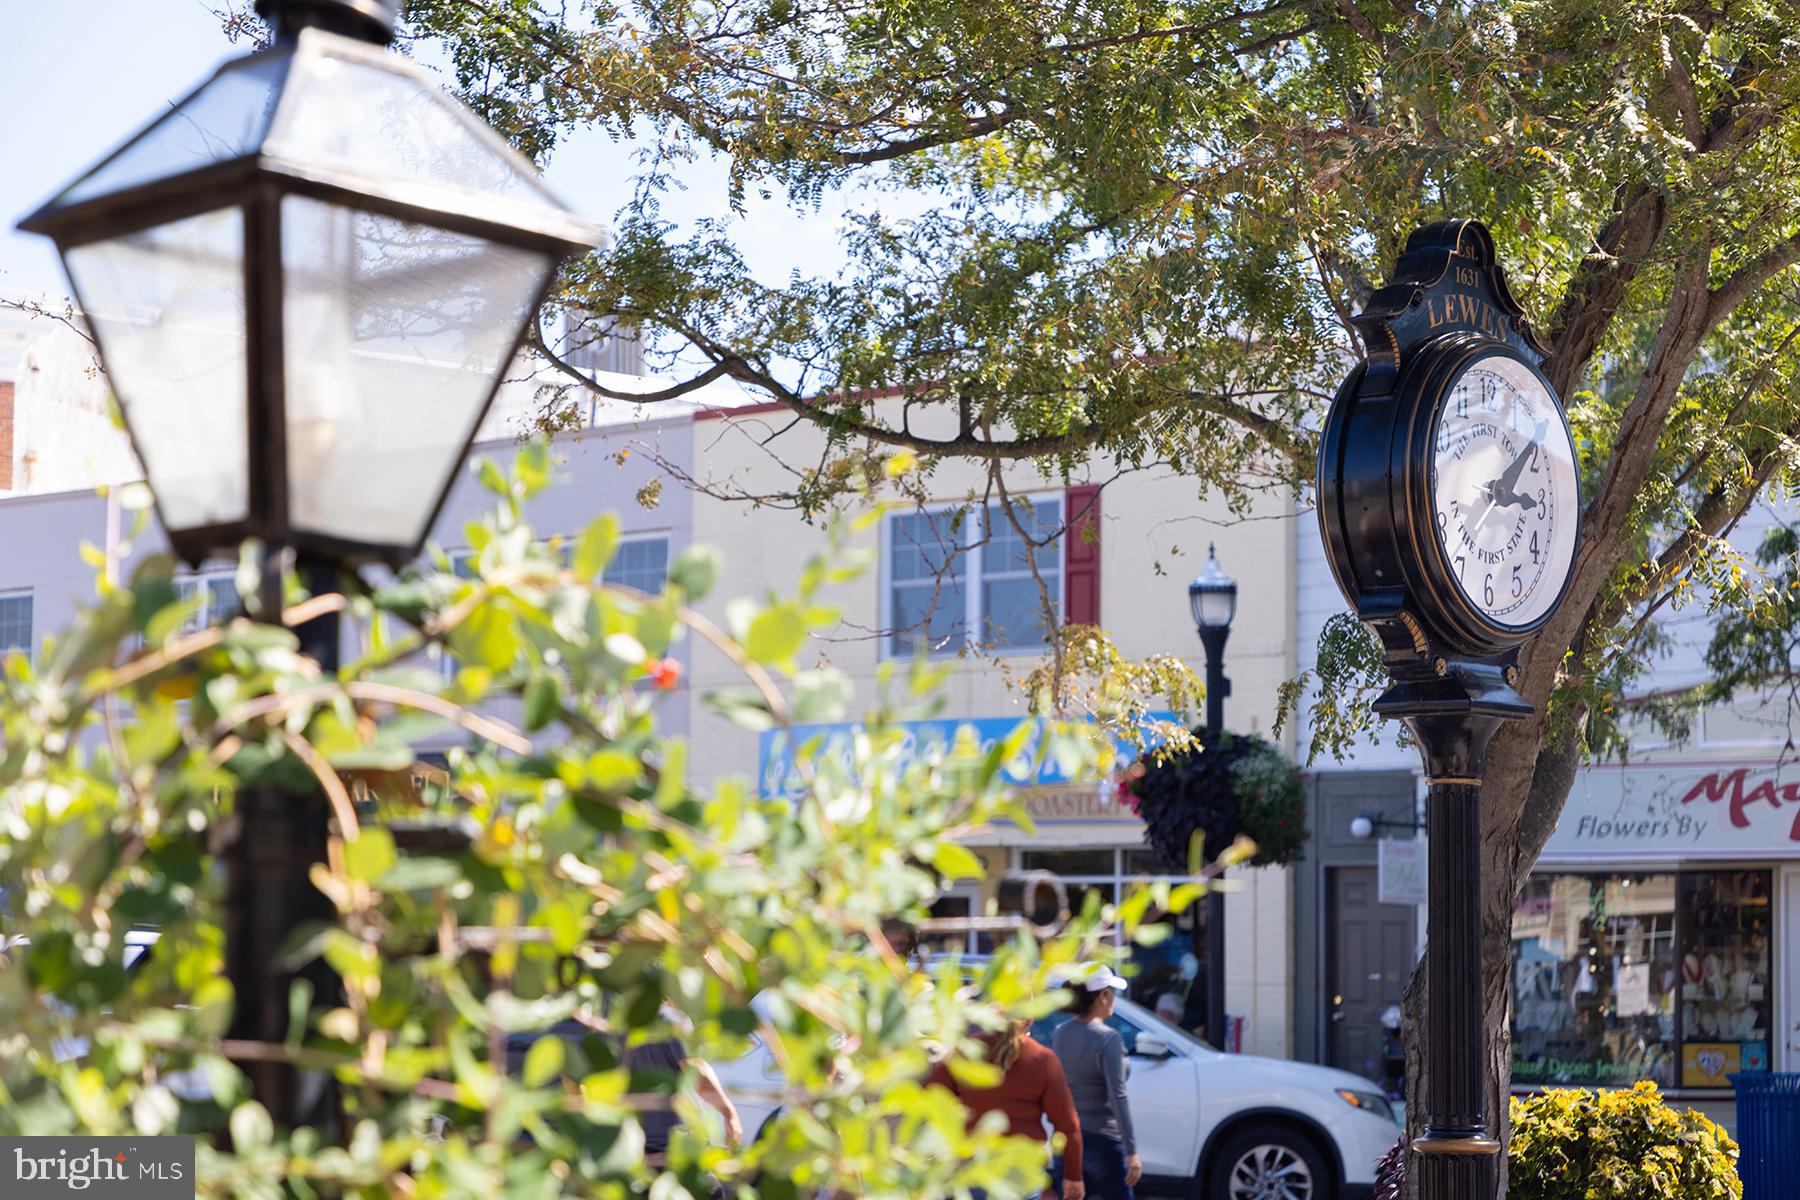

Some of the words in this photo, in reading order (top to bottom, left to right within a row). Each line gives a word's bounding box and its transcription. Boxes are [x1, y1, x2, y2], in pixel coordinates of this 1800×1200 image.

[1457, 240, 1479, 261] Est.
[1456, 266, 1479, 288] 1631
[1427, 294, 1511, 343] LEWES
[1456, 384, 1469, 420] 11
[1480, 376, 1497, 412] 12
[1511, 397, 1518, 433] 1
[1437, 419, 1450, 454] 0
[1453, 431, 1471, 461] THE
[1472, 422, 1498, 441] FIRST
[1502, 431, 1519, 461] TOW
[1529, 444, 1541, 474] 2
[1537, 488, 1546, 521] 3
[1450, 499, 1461, 520] IN
[1458, 521, 1476, 555] THE
[1478, 547, 1506, 566] FIRST
[1506, 512, 1528, 555] STATE
[1529, 530, 1541, 566] 4
[1454, 555, 1465, 584] 7
[1512, 563, 1523, 599] 5
[1484, 573, 1494, 607] 6
[1577, 814, 1670, 839] Flowers
[1677, 813, 1708, 842] By
